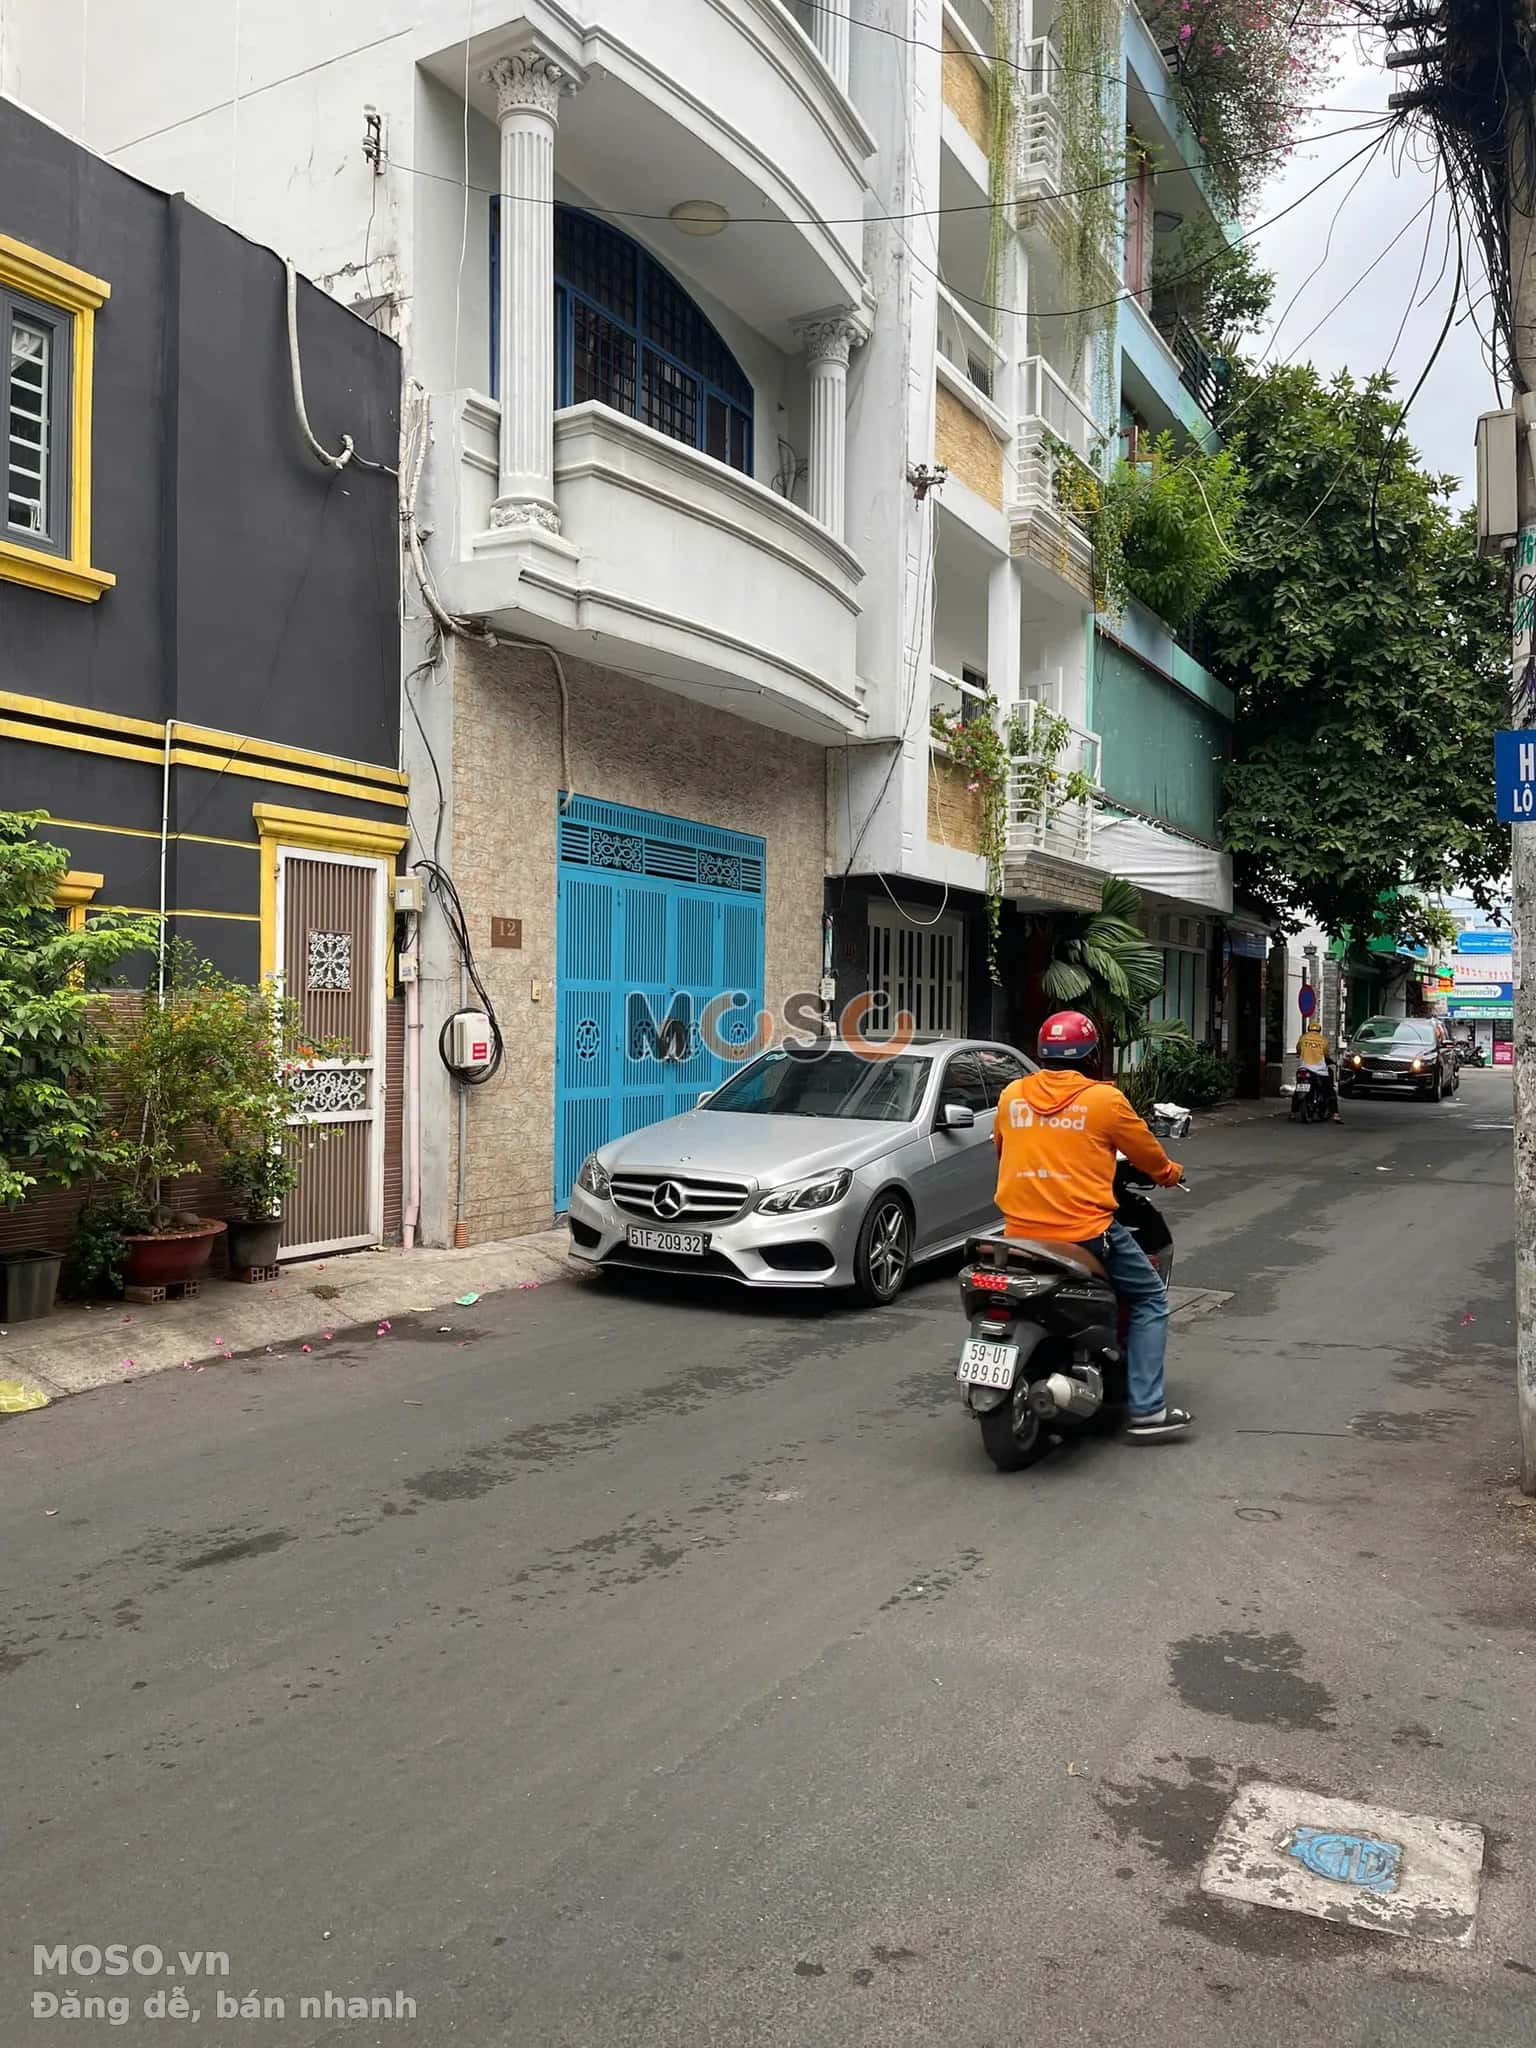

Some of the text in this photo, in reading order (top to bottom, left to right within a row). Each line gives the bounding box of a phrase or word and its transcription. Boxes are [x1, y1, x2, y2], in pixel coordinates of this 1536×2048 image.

[1513, 783, 1533, 816] LỘ
[499, 919, 517, 937] 12
[631, 1229, 701, 1253] 51F-209.32
